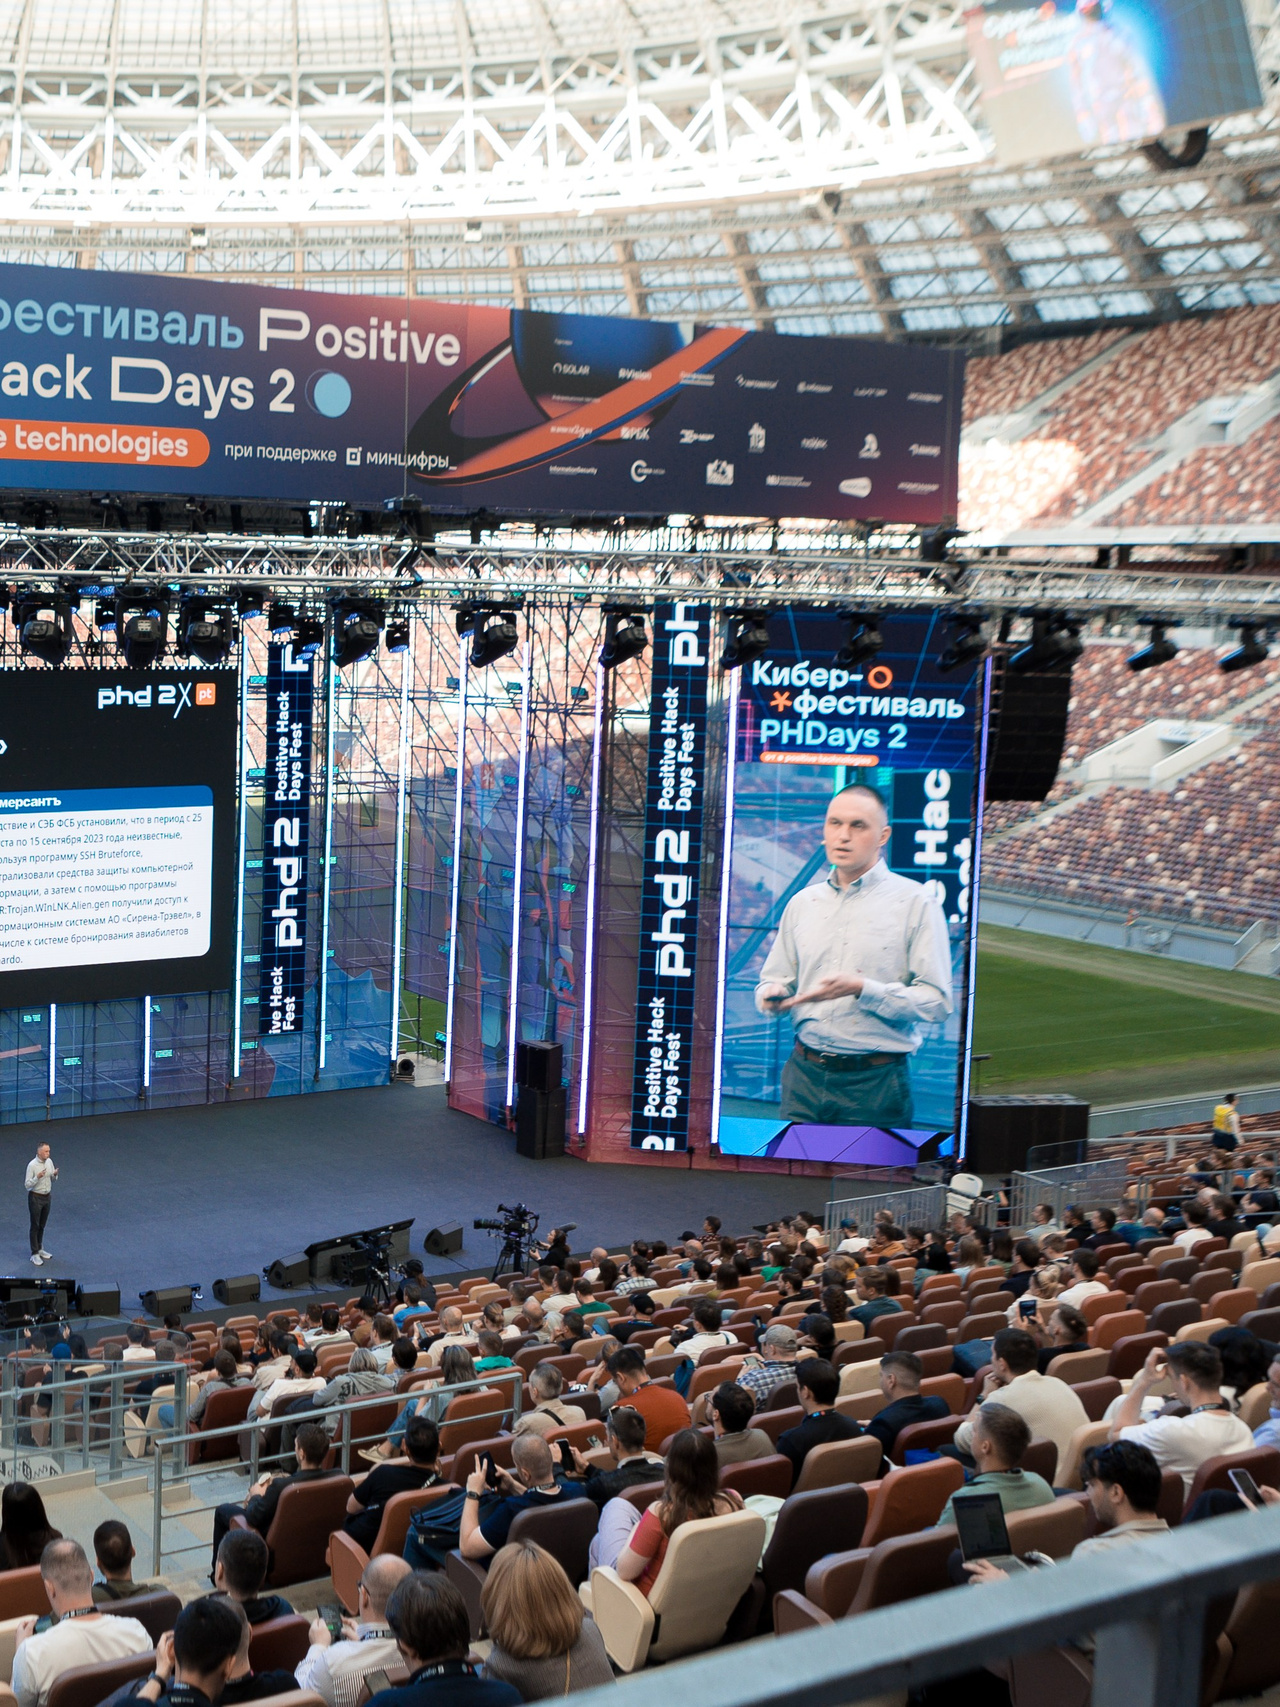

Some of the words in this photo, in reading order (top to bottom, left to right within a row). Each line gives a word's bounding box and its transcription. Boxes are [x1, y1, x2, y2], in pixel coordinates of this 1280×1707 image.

[259, 307, 461, 367] Positive
[111, 356, 255, 419] Days
[269, 368, 296, 413] 2
[15, 423, 189, 462] technologies
[225, 444, 253, 460] при
[257, 445, 337, 464] поддержке
[752, 660, 863, 691] Кибер-
[98, 685, 151, 709] phd
[199, 688, 212, 701] pt
[793, 689, 965, 720] фестиваль
[661, 686, 680, 734] Hack
[678, 723, 695, 763] Fest
[760, 719, 881, 753] PHDays
[887, 723, 908, 749] 2
[657, 738, 677, 810] Positive
[675, 767, 696, 811] Days
[38, 819, 54, 829] СЭБ
[57, 818, 75, 827] ФСБ
[77, 816, 129, 828] установили,
[131, 816, 144, 825] что
[154, 814, 184, 825] период
[192, 813, 202, 822] 25
[16, 838, 27, 847] по
[30, 837, 40, 845] 15
[42, 834, 82, 847] сентября
[84, 834, 103, 844] 2023
[106, 834, 125, 844] года
[127, 830, 183, 842] неизвестные,
[29, 853, 78, 865] программу
[80, 851, 96, 860] SSH
[98, 849, 143, 860] Bruteforce,
[56, 868, 94, 880] средства
[96, 866, 129, 877] защиты
[131, 861, 193, 875] компьютерной
[51, 885, 76, 895] затем
[84, 883, 127, 894] помощью
[129, 880, 177, 892] программы
[112, 897, 152, 909] получили
[154, 895, 182, 907] доступ
[65, 916, 106, 928] системам
[108, 915, 120, 924] АО
[0, 939, 24, 949] числе
[34, 937, 68, 947] системе
[71, 931, 133, 946] бронирования
[136, 927, 188, 940] авиабилетов
